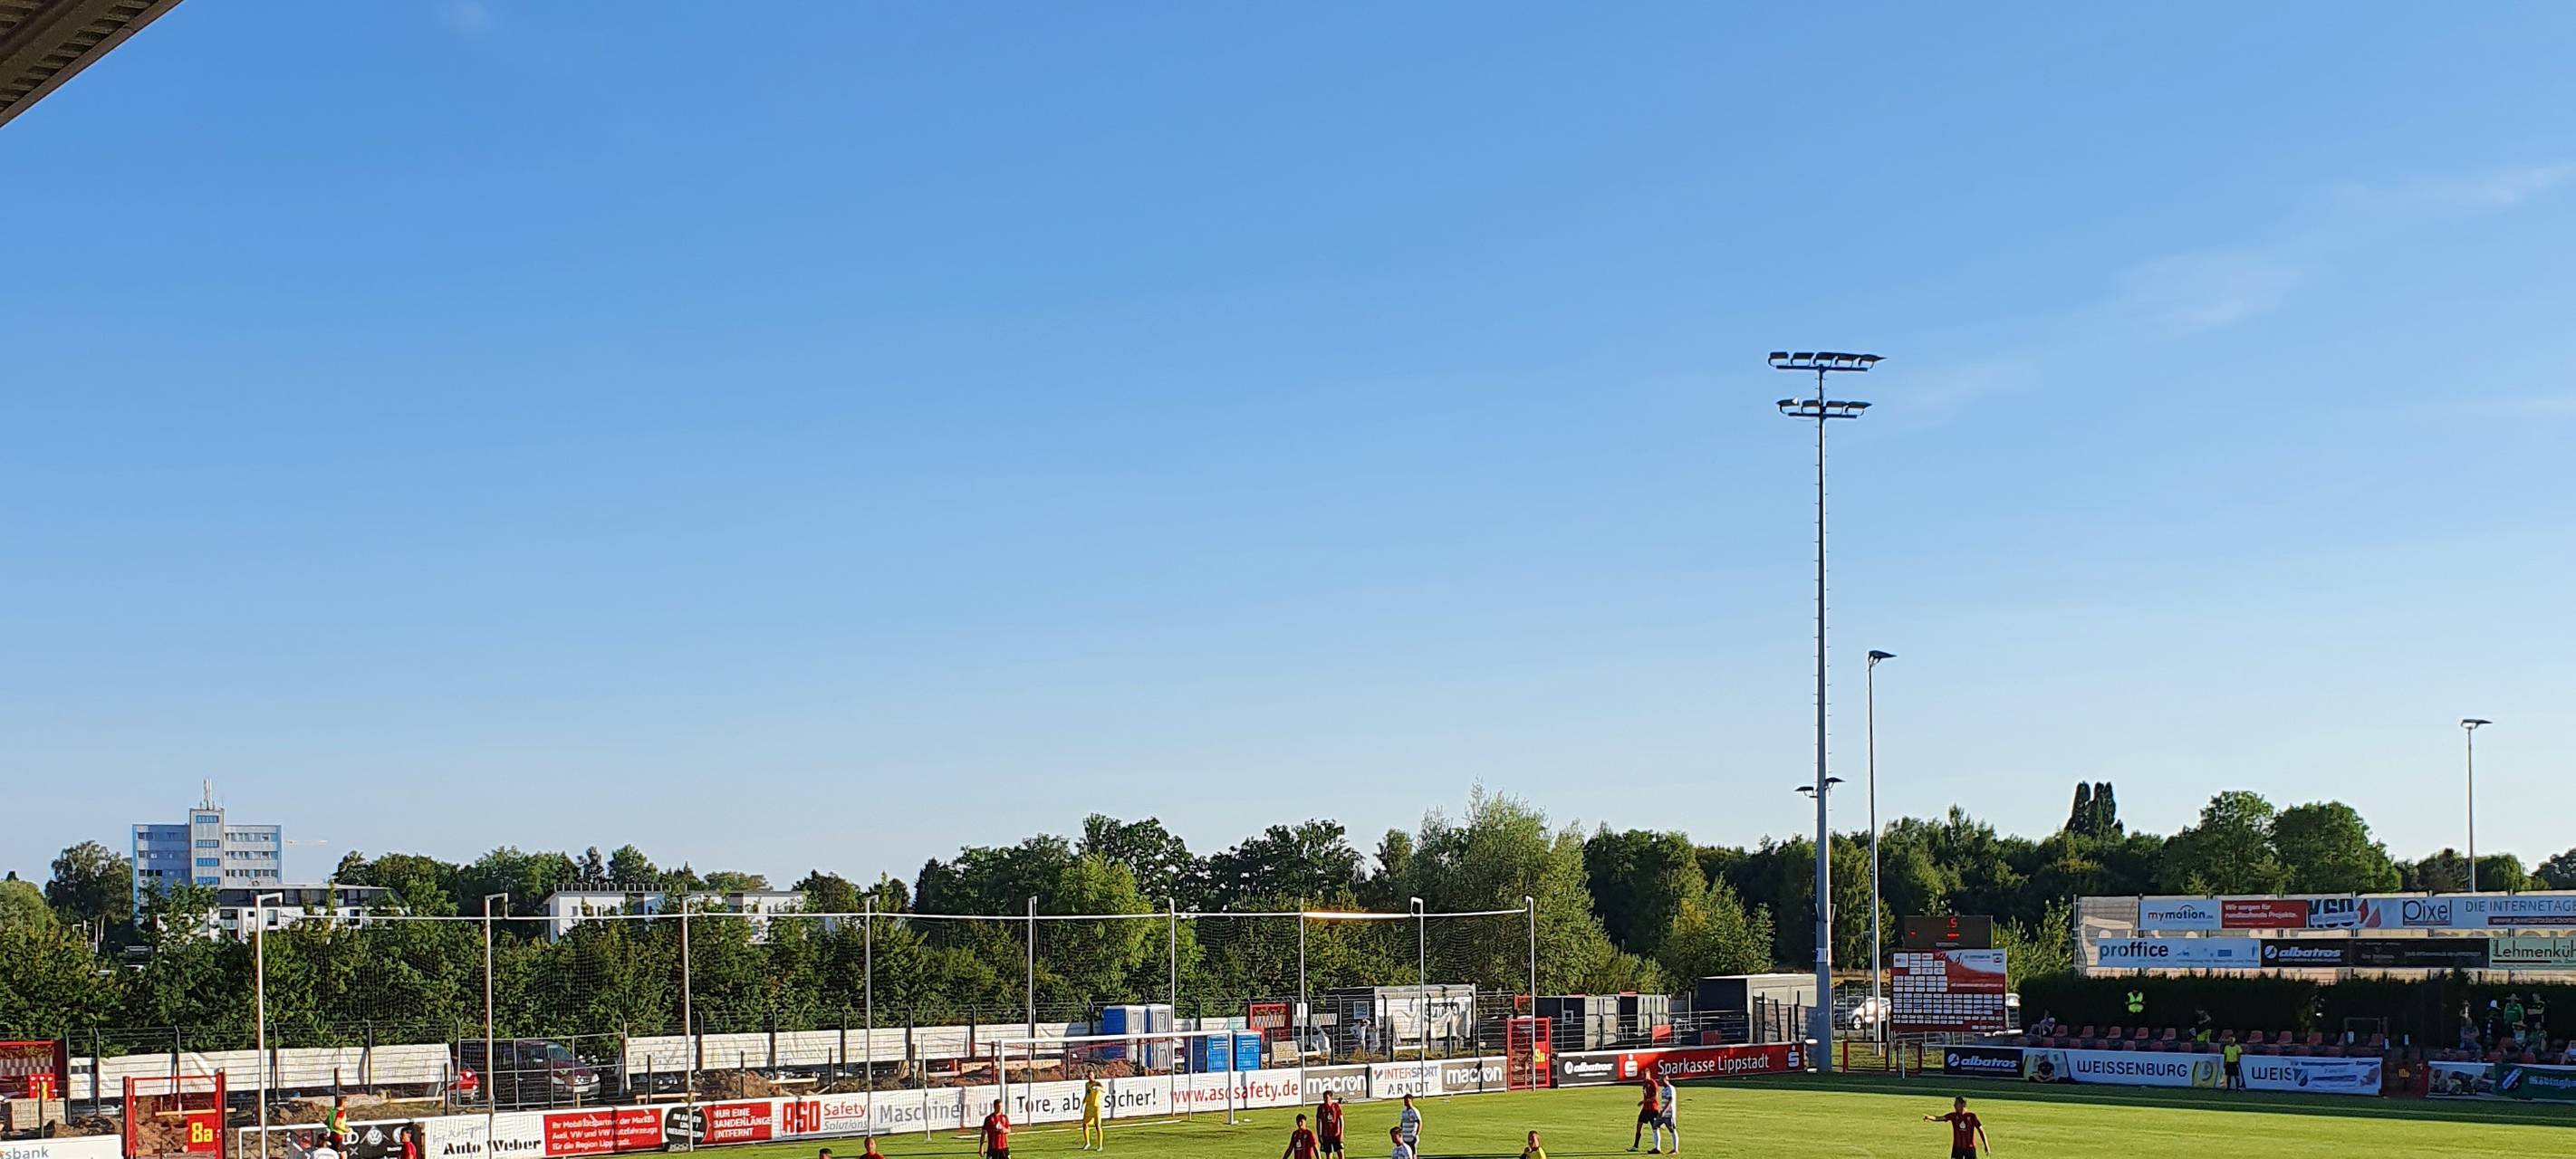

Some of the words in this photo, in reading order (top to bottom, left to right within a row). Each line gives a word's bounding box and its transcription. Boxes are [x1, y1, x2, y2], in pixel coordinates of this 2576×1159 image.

[2403, 900, 2452, 926] Pixel
[2465, 901, 2485, 912] DIE
[2099, 942, 2169, 961] proffice
[2279, 946, 2341, 957] albatros
[2493, 939, 2576, 958] Lehmenküh
[1573, 1061, 1614, 1073] albatros
[1658, 1057, 1715, 1076] Sparkasse
[1717, 1052, 1770, 1074] Lippstadt
[1960, 1055, 2017, 1068] albatros
[2076, 1059, 2188, 1078] WEISSENBURG
[1385, 1066, 1438, 1080] INTERSPORT
[1447, 1066, 1503, 1085] macron
[1306, 1074, 1367, 1095] macron
[1388, 1081, 1429, 1096] ARNDT
[1015, 1095, 1055, 1115] Tore,
[1103, 1087, 1157, 1108] sicher!
[713, 1108, 731, 1119] NUR
[732, 1107, 751, 1117] EINE
[823, 1102, 867, 1117] Safety
[823, 1117, 868, 1131] Solutions
[191, 1121, 214, 1143] 8a
[570, 1130, 583, 1138] VW
[584, 1129, 597, 1137] und
[443, 1141, 481, 1155] Auto
[486, 1138, 542, 1152] Weber
[563, 1141, 574, 1150] die
